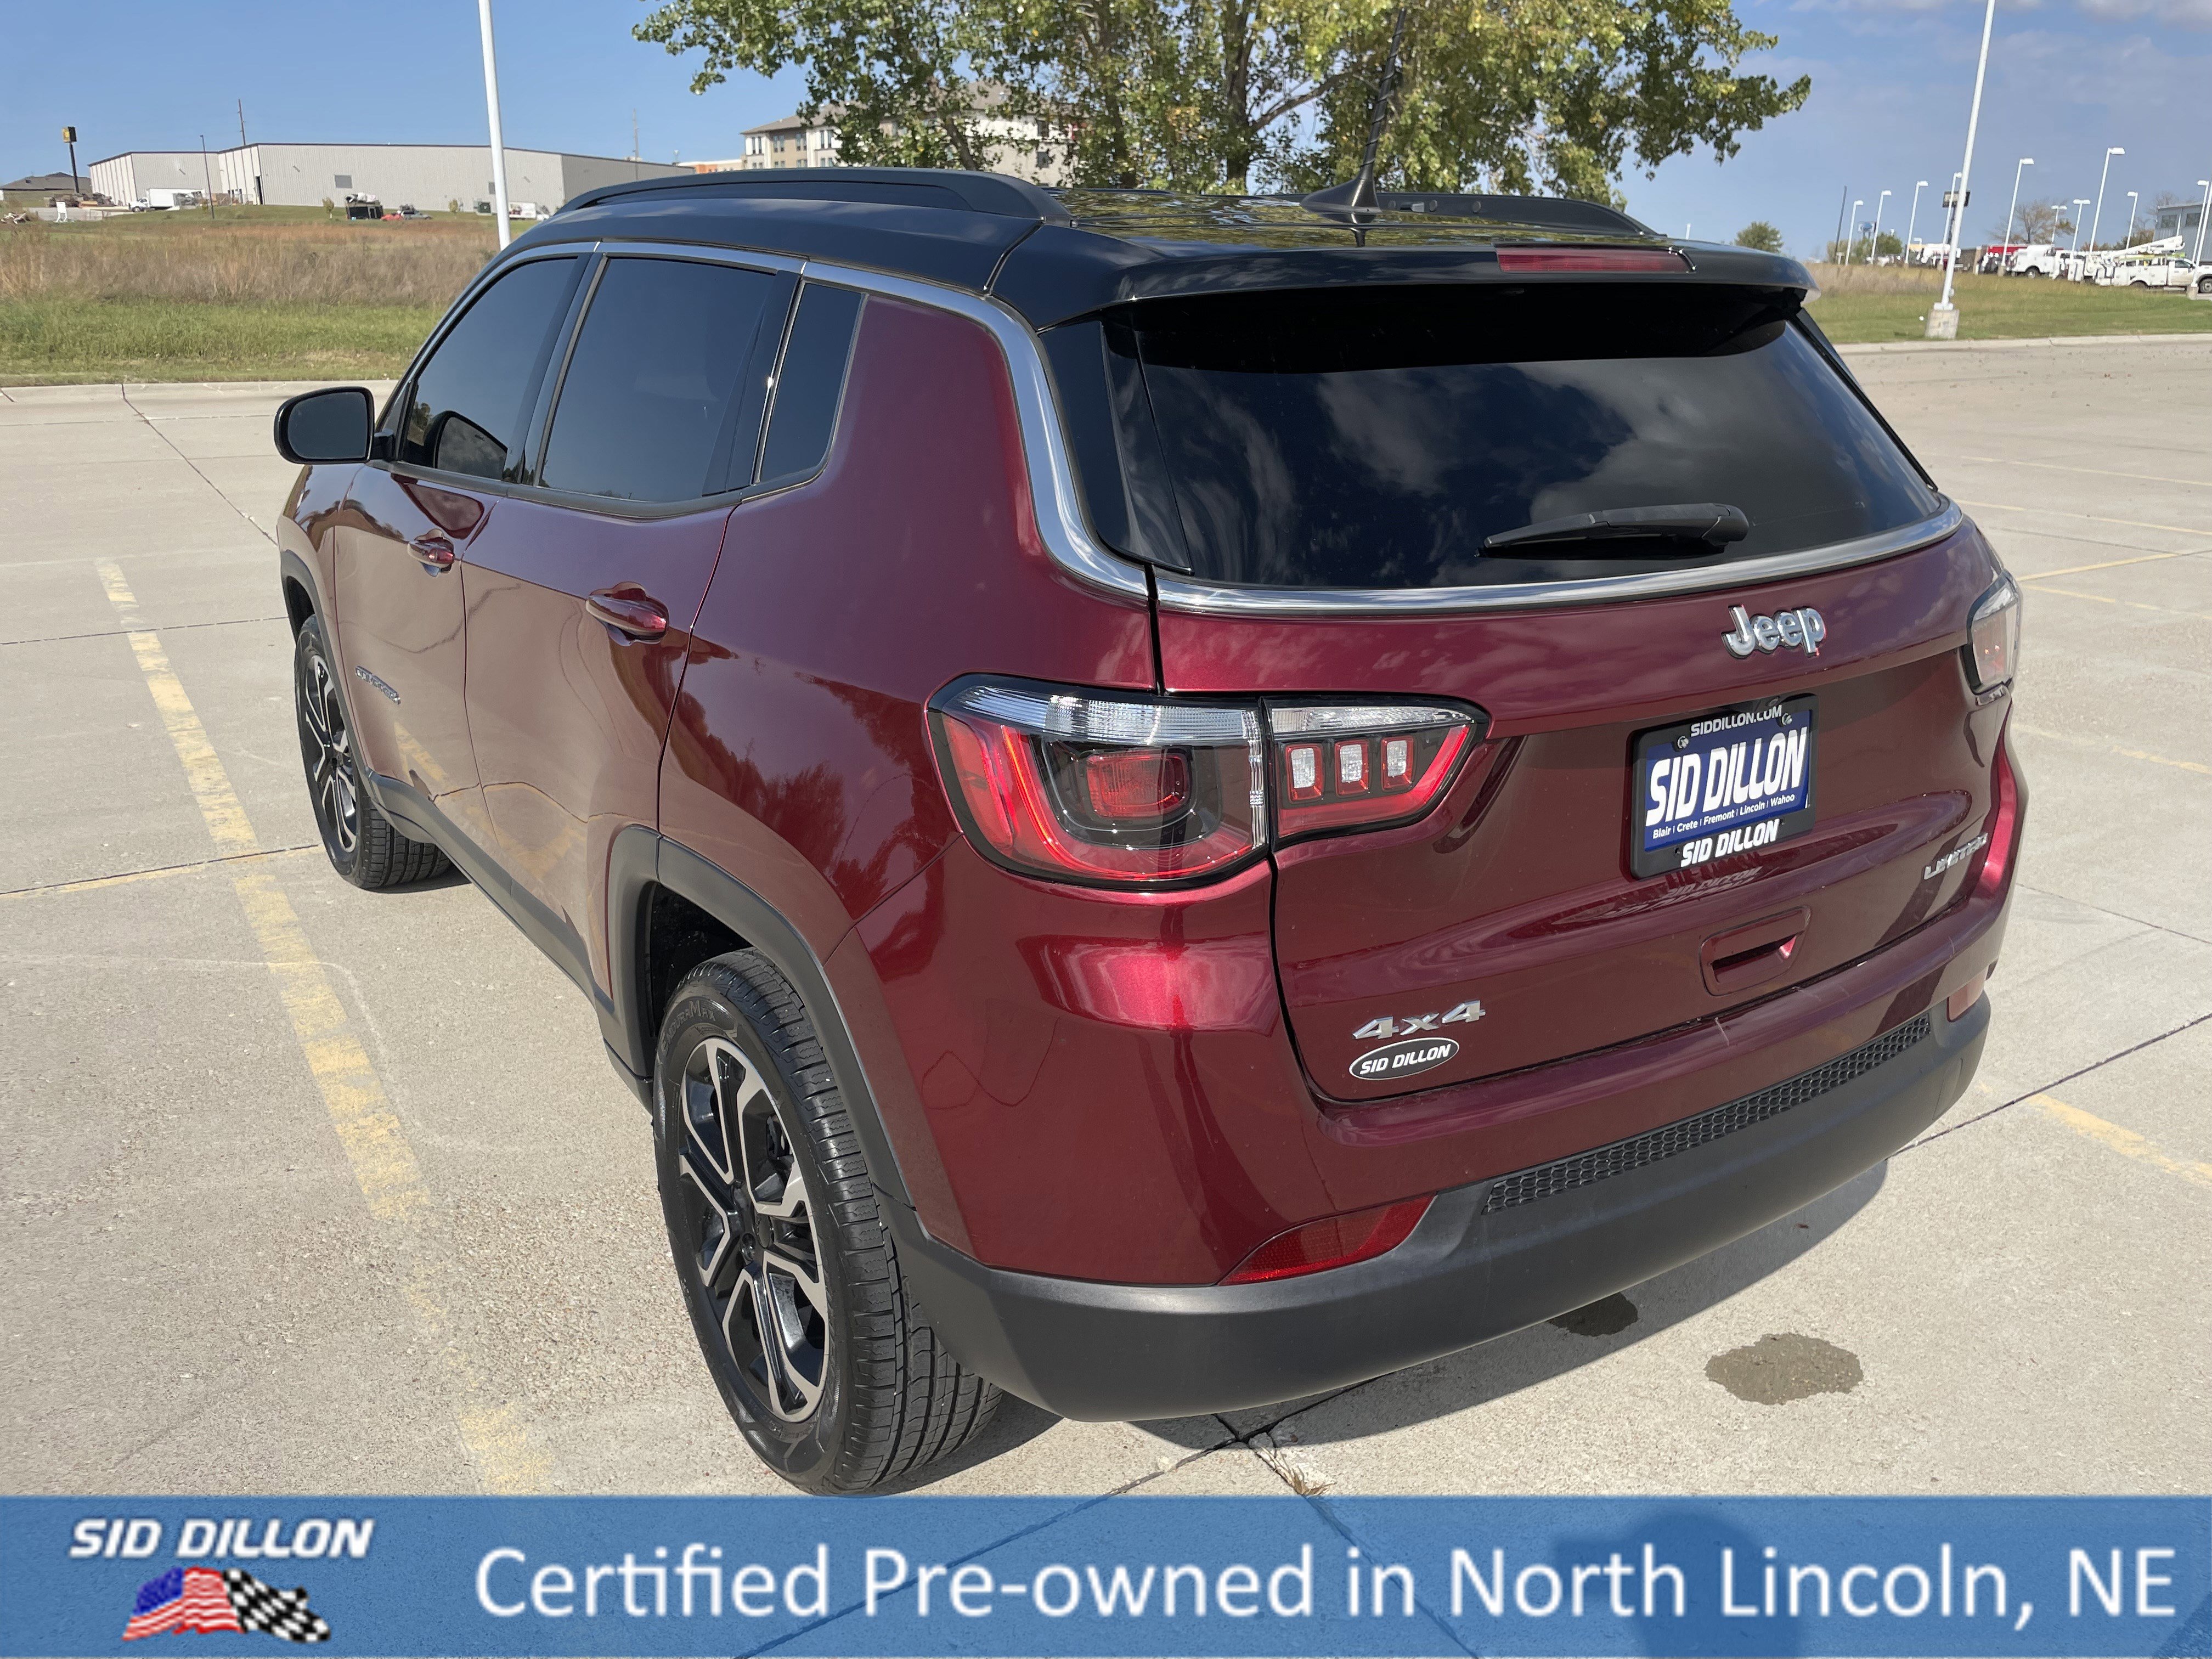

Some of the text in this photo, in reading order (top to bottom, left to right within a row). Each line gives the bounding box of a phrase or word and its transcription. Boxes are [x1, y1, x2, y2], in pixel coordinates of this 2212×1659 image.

[1722, 604, 1827, 658] Jeep
[1690, 704, 1782, 737] SIDDILLON.COM
[1645, 726, 1808, 827] SID DILLON
[1652, 794, 1795, 839] Blair Crete Fremont Lincoln Wahoo
[1680, 819, 1780, 867] SID DILLON
[1352, 1000, 1486, 1040] 4x4
[1359, 1043, 1451, 1075] SID DILLON
